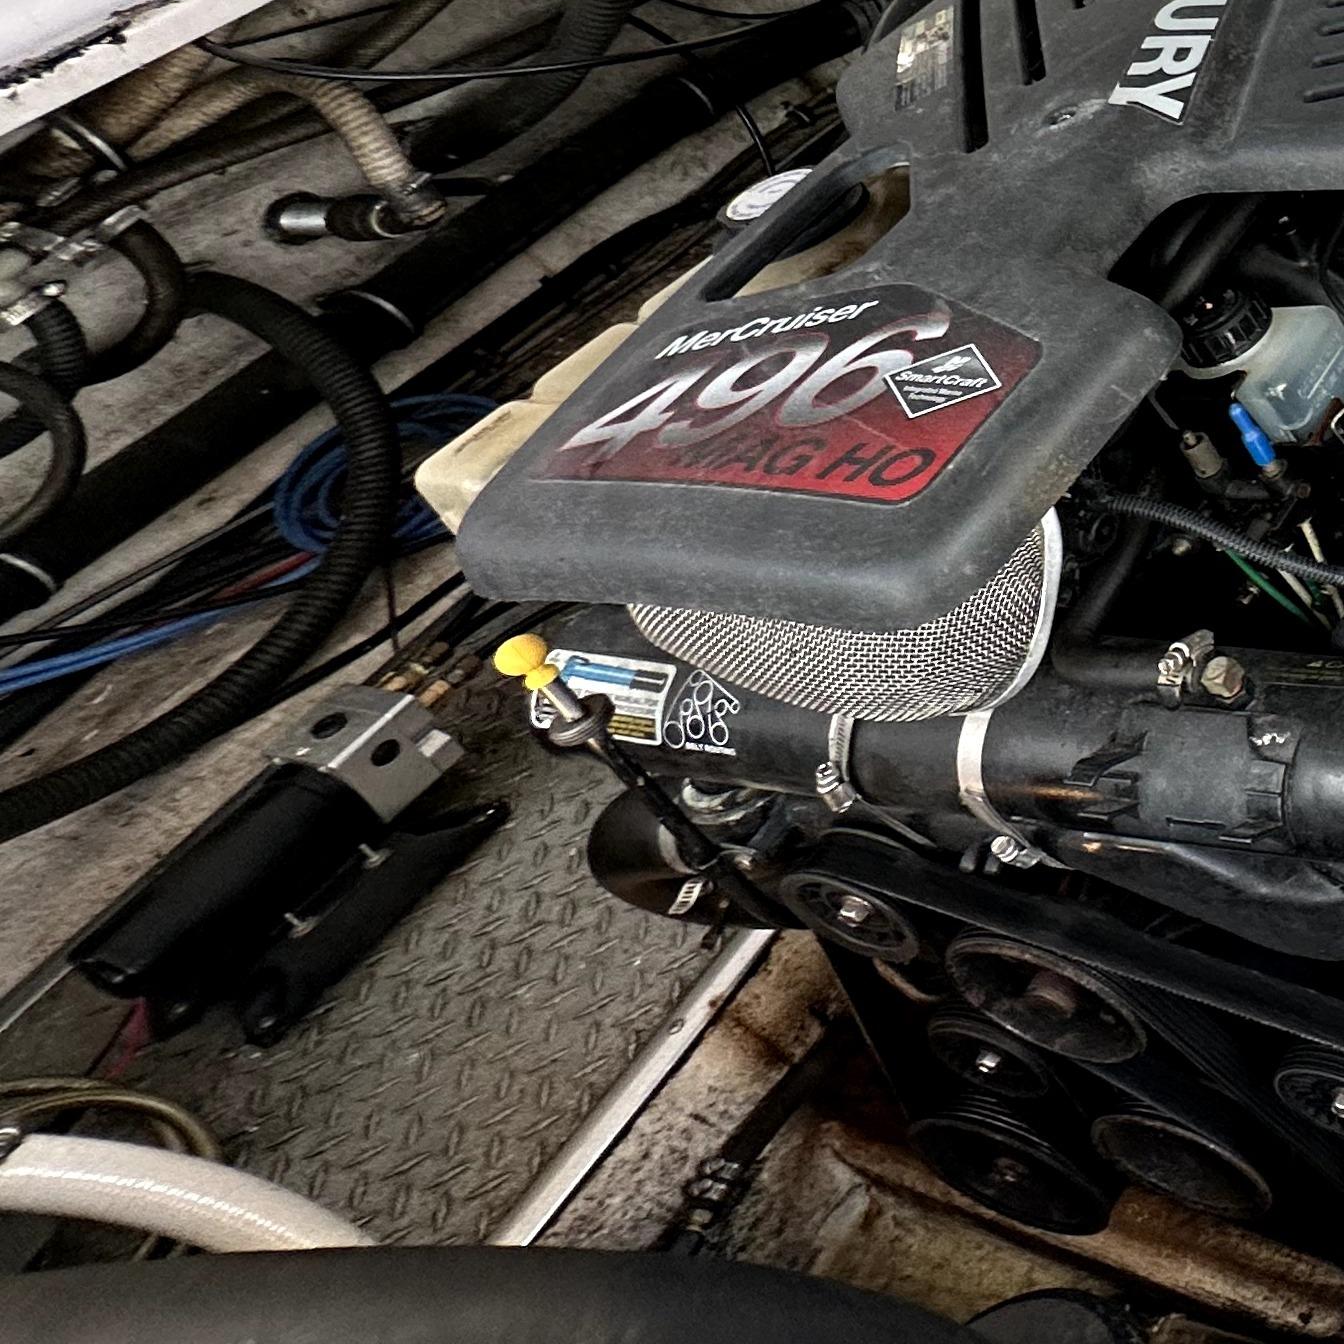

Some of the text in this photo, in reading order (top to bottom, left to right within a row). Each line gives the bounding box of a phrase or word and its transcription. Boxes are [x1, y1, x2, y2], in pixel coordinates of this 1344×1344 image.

[655, 300, 879, 360] MerCruiser
[560, 312, 951, 462] 496
[815, 442, 938, 487] HO
